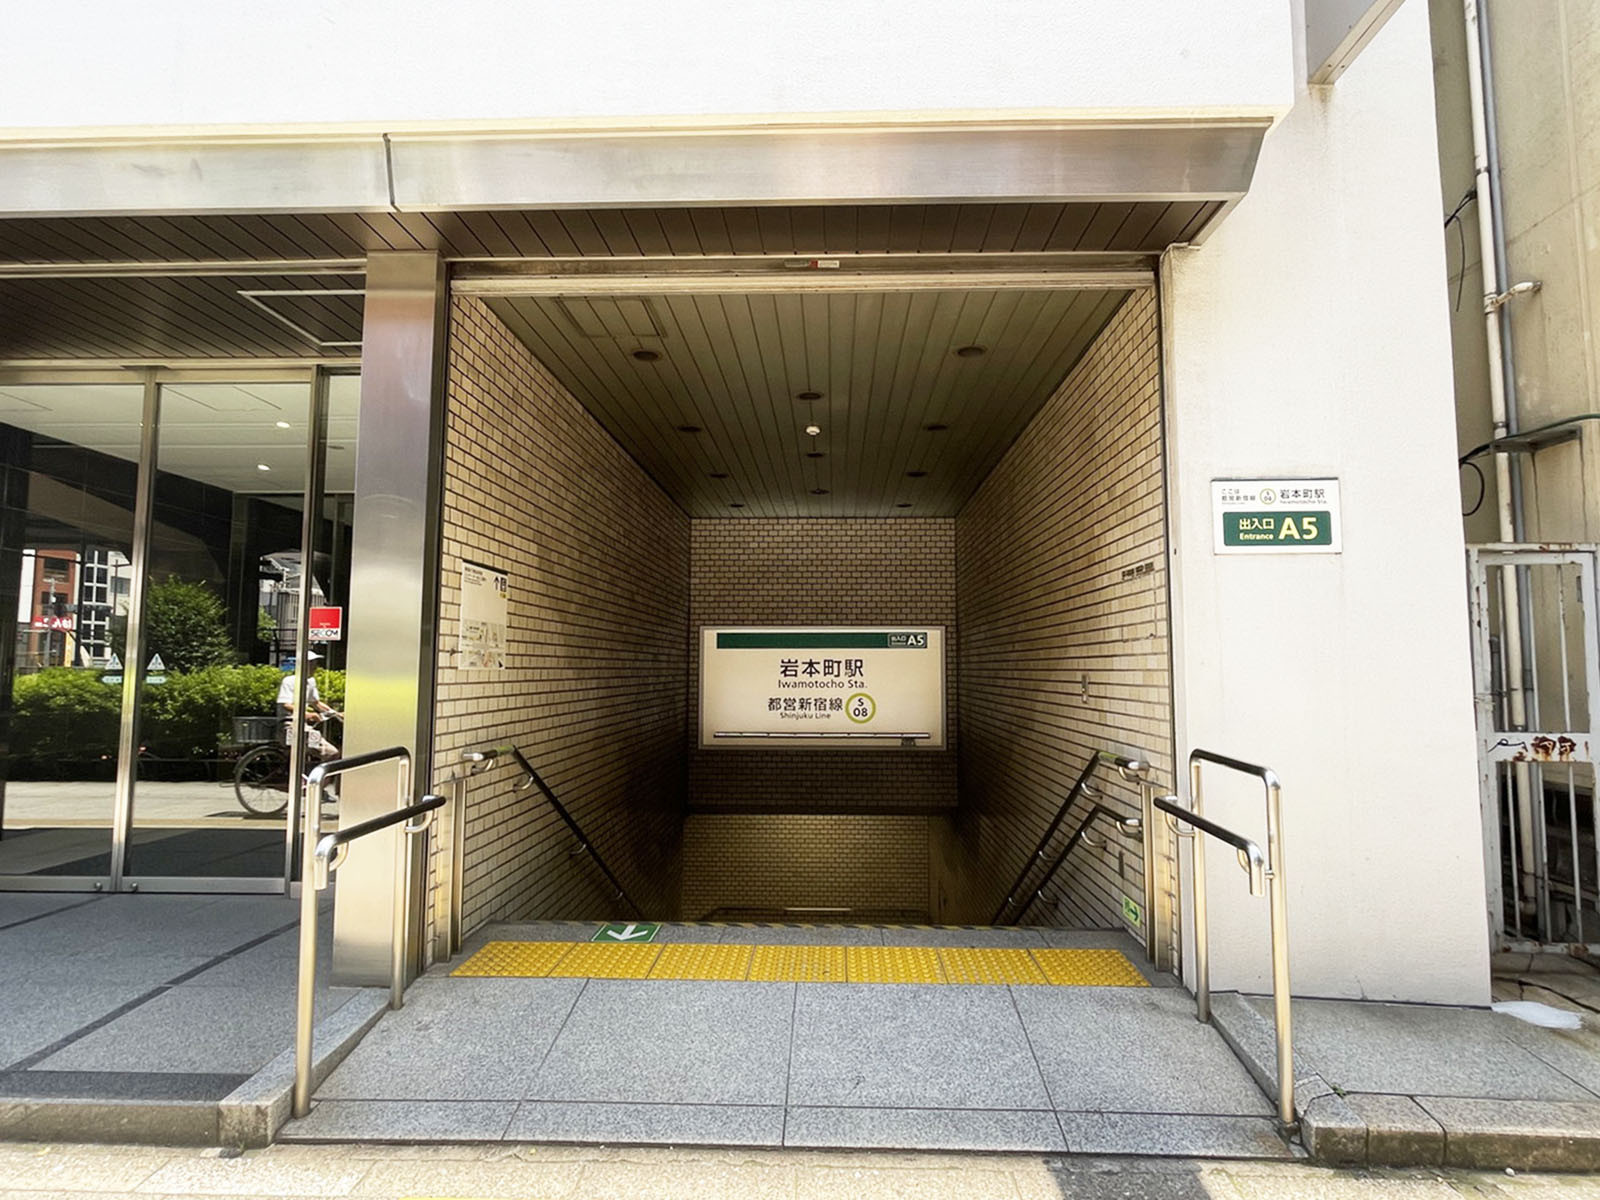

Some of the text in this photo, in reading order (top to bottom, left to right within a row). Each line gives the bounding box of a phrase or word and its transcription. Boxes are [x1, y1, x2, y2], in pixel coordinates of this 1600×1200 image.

[1280, 488, 1325, 499] 岩本町駅
[1239, 518, 1274, 530] 出入口
[1278, 516, 1318, 540] A5
[1239, 532, 1274, 540] Entrance
[907, 634, 924, 646] A5
[780, 658, 864, 678] 岩本町駅
[778, 679, 868, 689] Iwamotocho Sta.
[768, 697, 843, 712] 都営新宿線
[857, 698, 865, 707] S
[780, 712, 813, 720] Shinjuku
[853, 707, 868, 718] 08
